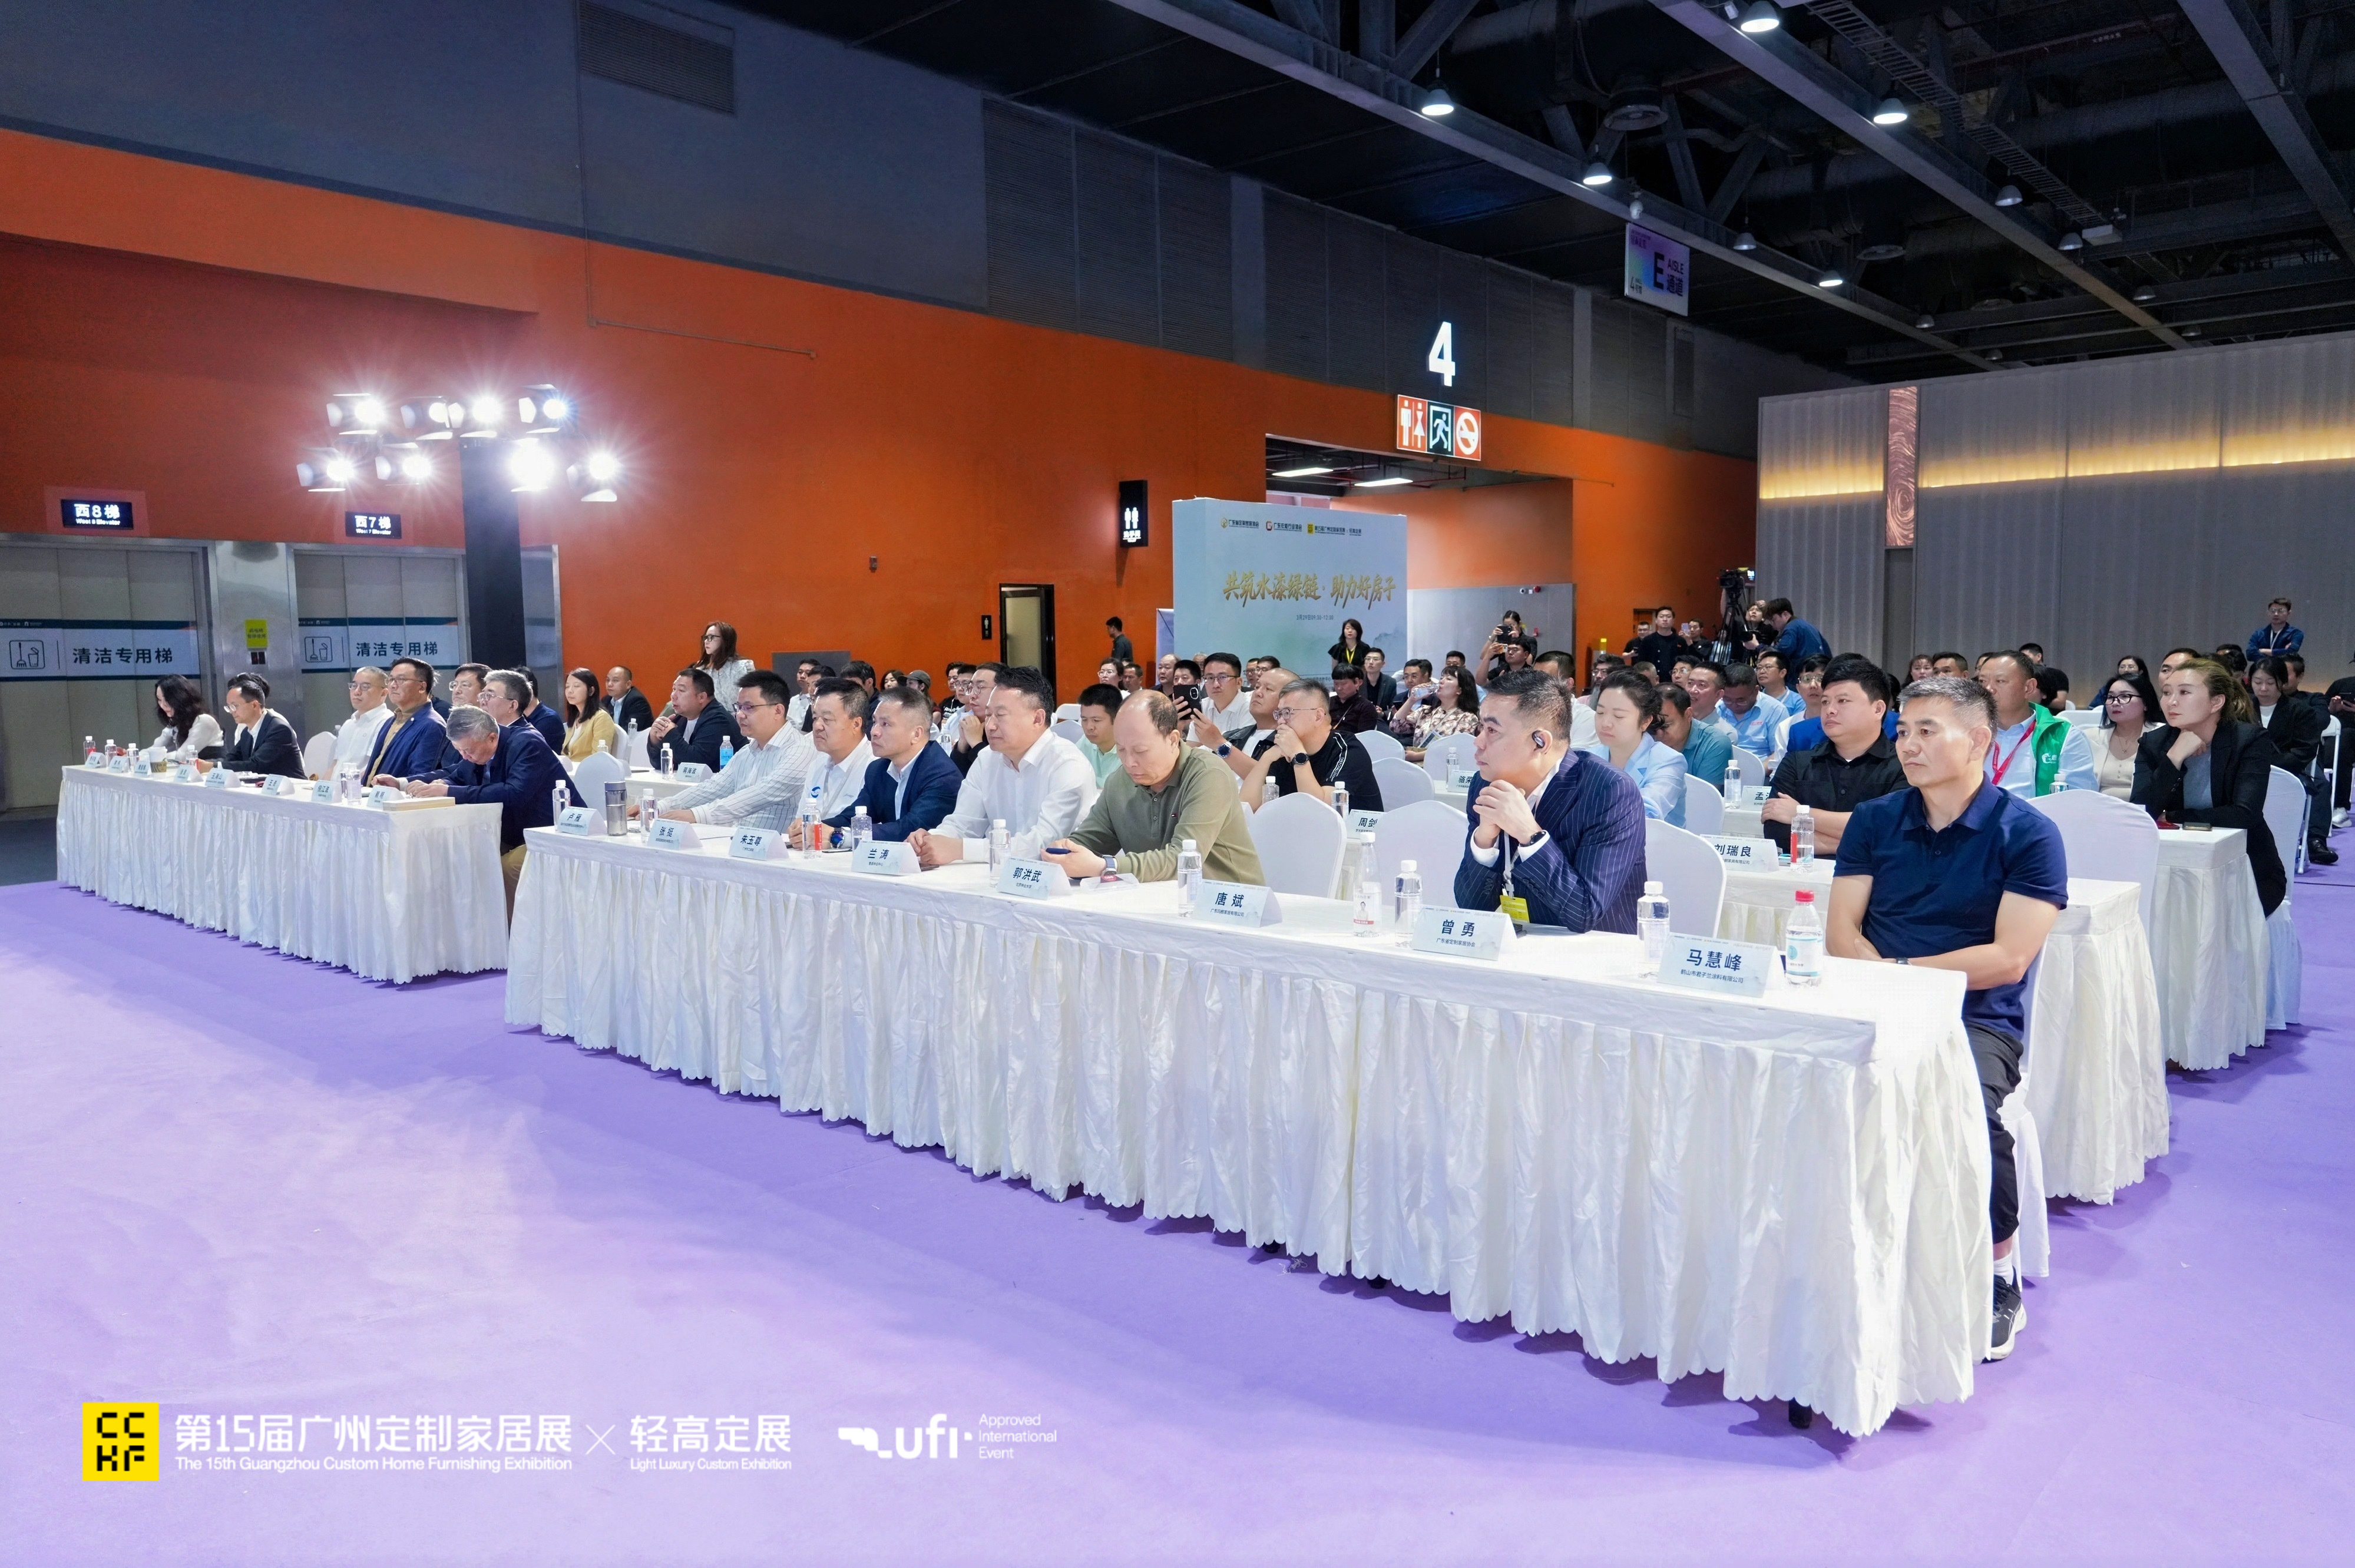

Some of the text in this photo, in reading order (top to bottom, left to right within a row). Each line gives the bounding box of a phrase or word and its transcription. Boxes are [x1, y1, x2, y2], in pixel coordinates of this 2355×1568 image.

[1653, 252, 1665, 290] E
[1668, 259, 1684, 274] AISLE
[1667, 273, 1683, 297] 通道
[1428, 321, 1456, 387] 4
[74, 504, 120, 519] 西8梯
[355, 515, 391, 529] 西7梯
[72, 647, 173, 664] 清洁专用梯
[356, 641, 438, 657] 清洁专用梯
[1358, 818, 1378, 828] 周剑
[740, 834, 762, 846] 朱玉尊
[868, 848, 889, 859] 兰涛
[1714, 844, 1751, 857] 刘瑞良
[1013, 867, 1042, 882] 郭洪武
[1215, 892, 1244, 908] 唐斌
[1441, 919, 1475, 937] 曾勇
[1437, 938, 1476, 947] 广东省定制家居协会
[1686, 949, 1742, 971] 马慧峰
[1681, 969, 1744, 984] 鹤山市君子兰涂料有限公司
